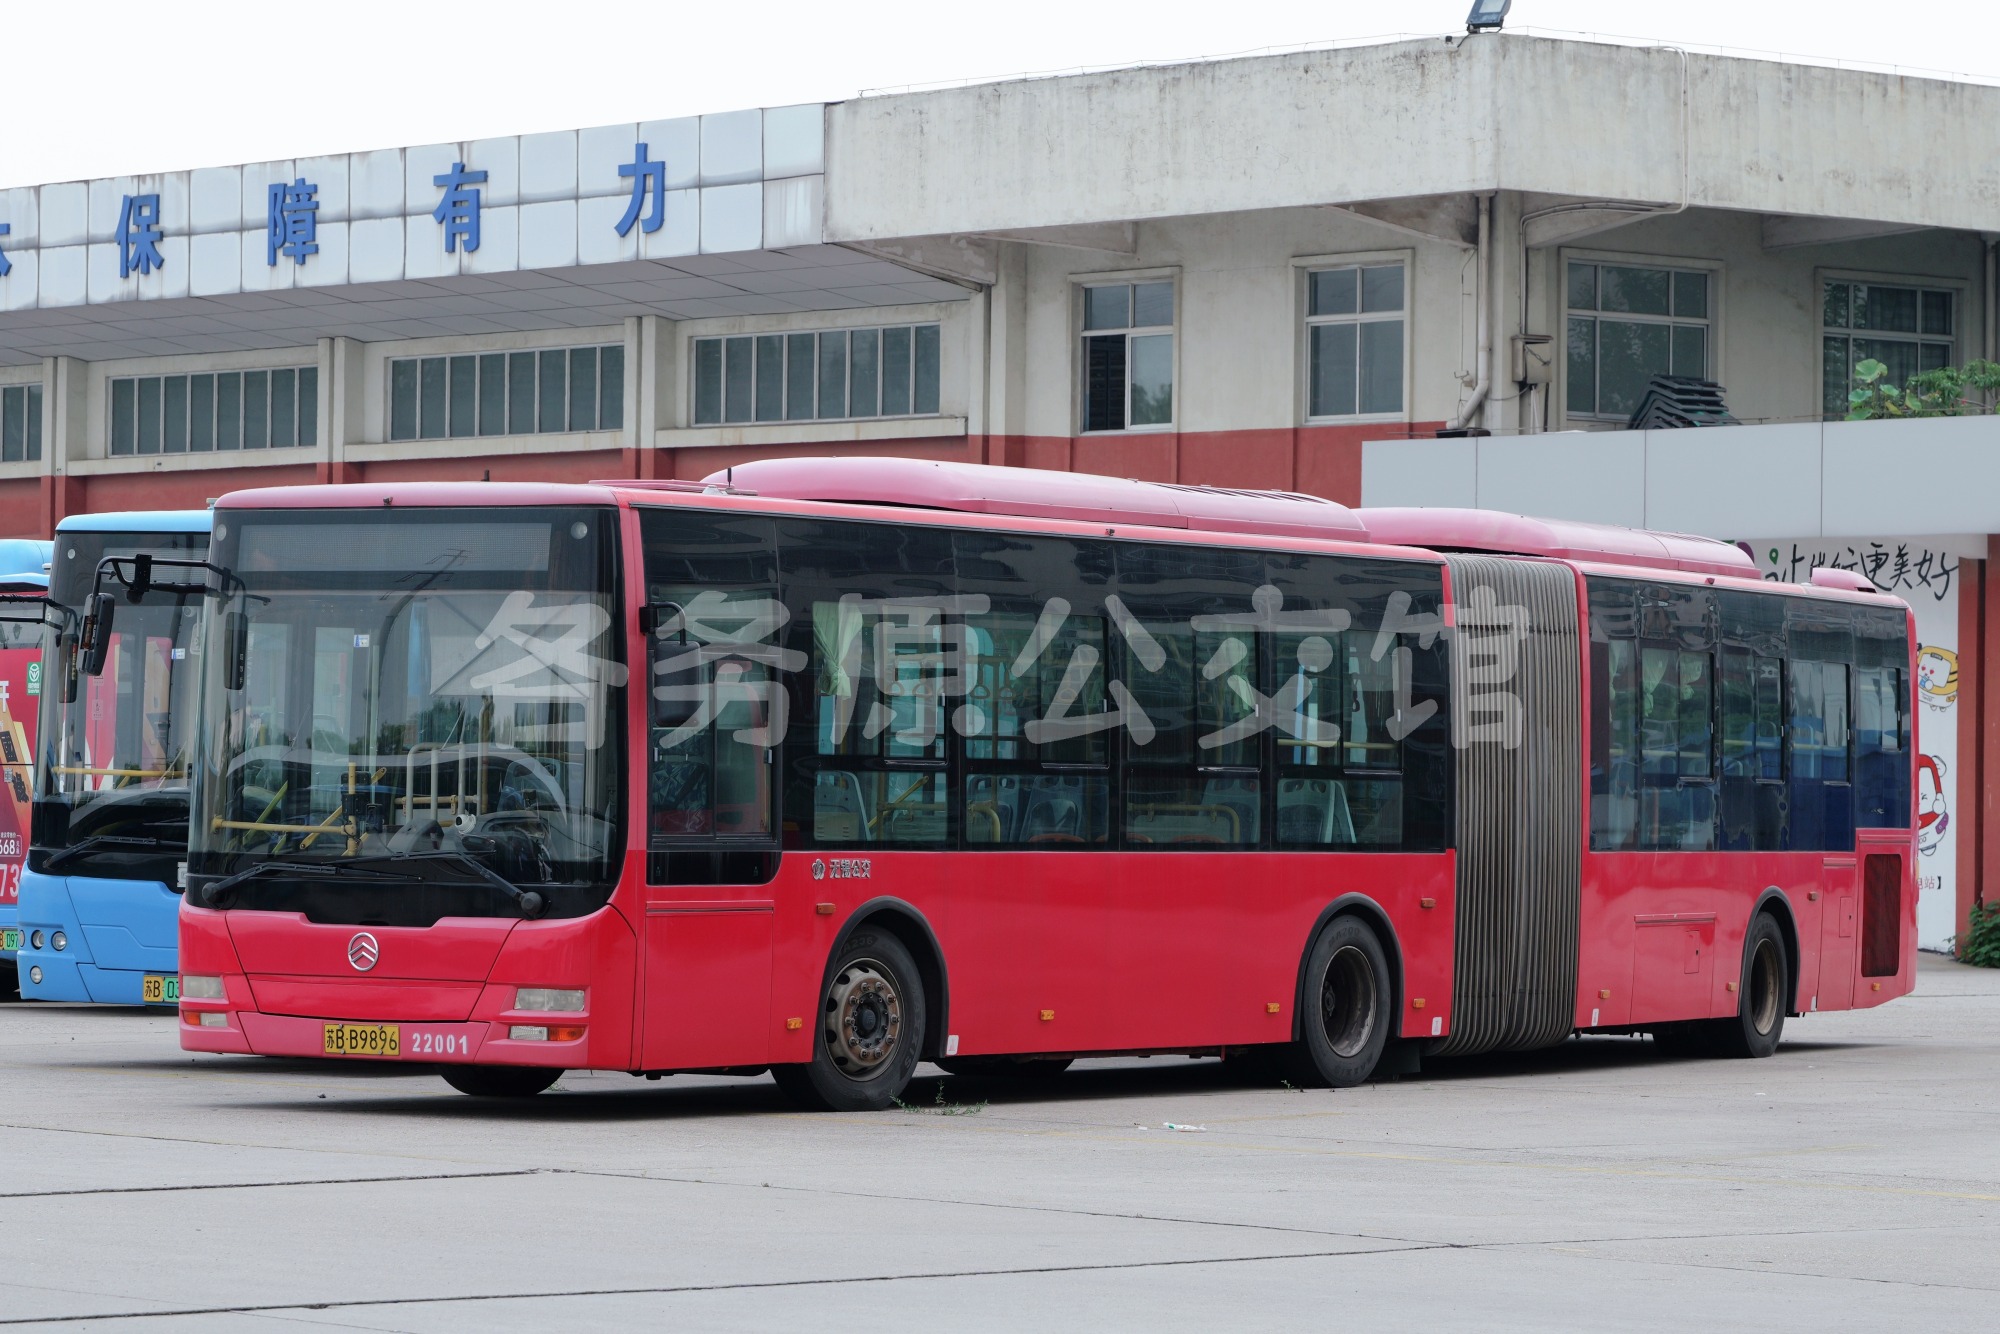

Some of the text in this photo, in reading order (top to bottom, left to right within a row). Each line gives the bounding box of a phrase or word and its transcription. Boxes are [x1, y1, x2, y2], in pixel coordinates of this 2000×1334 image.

[829, 858, 871, 879] 无锡公交
[412, 1032, 468, 1055] 22001
